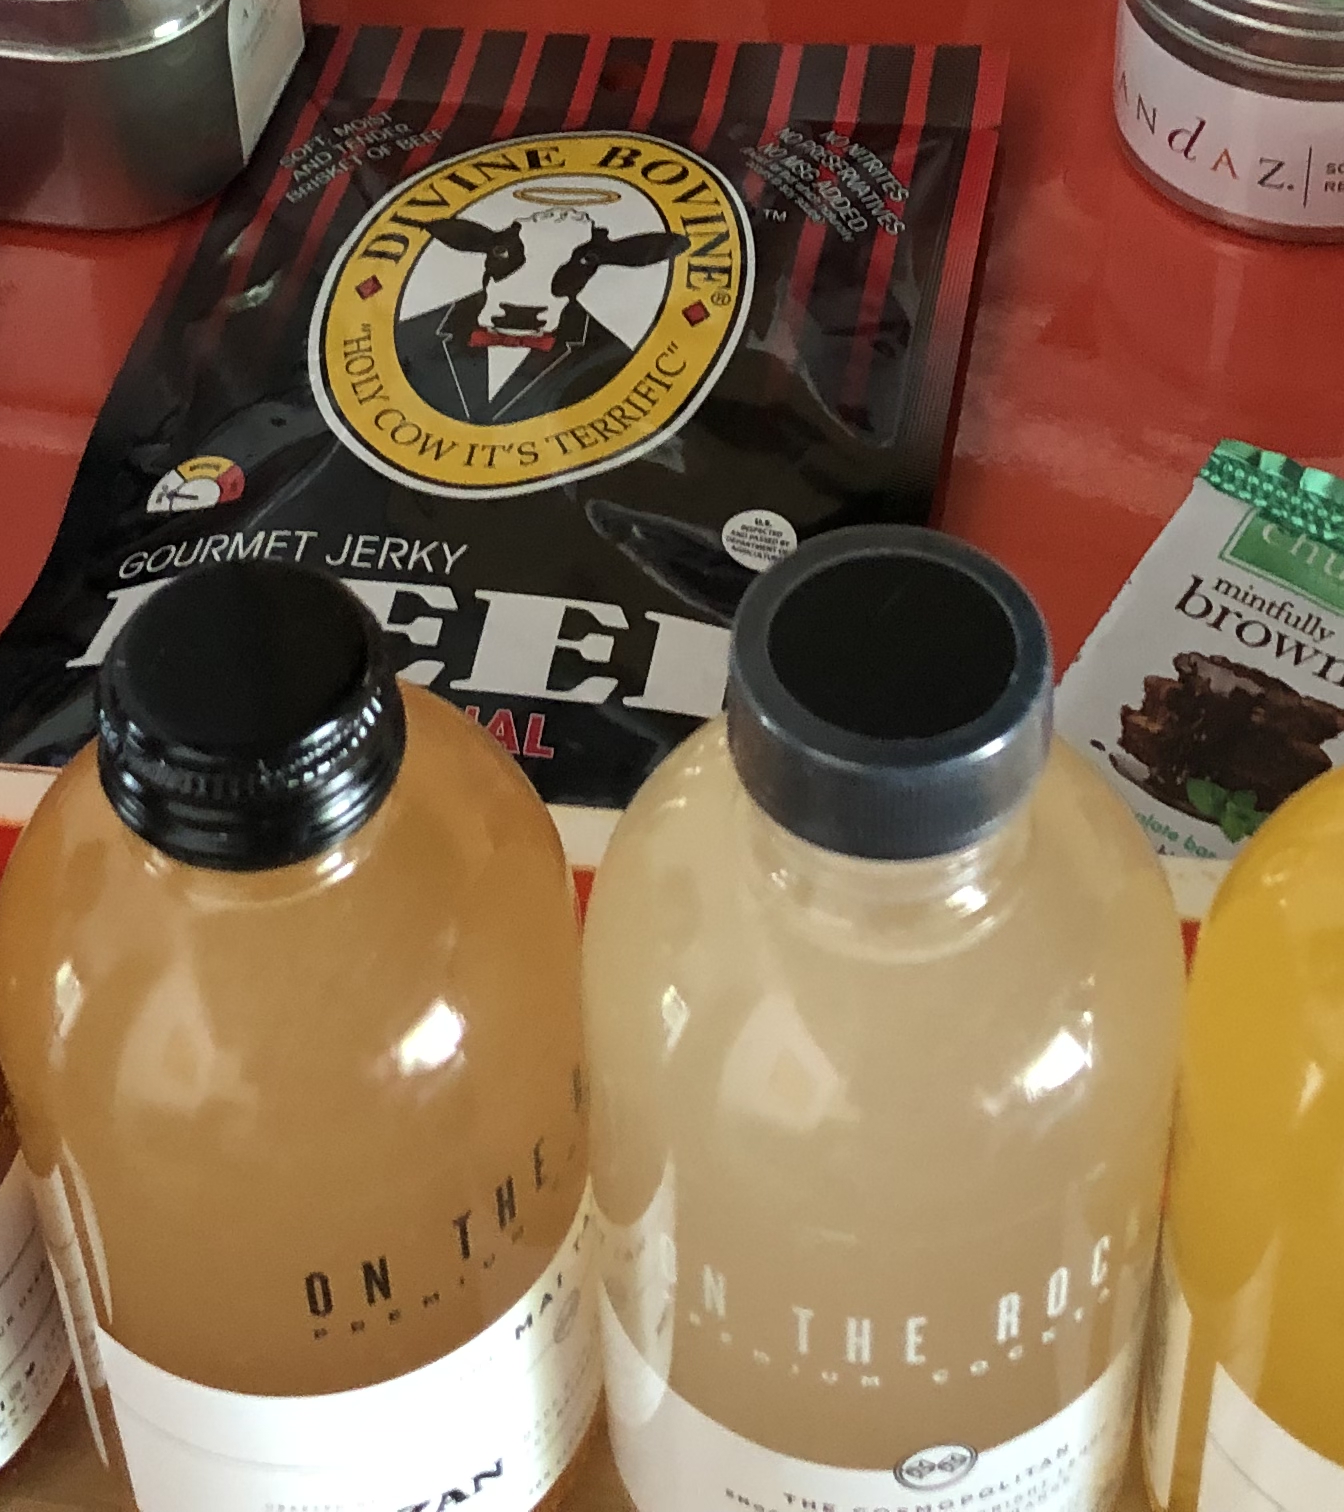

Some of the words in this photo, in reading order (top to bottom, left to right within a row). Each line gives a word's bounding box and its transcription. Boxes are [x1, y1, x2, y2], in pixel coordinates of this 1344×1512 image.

[292, 150, 333, 183] AND
[331, 122, 413, 155] TENDER
[332, 111, 394, 138] MOIST
[285, 153, 363, 205] BRISKET
[366, 144, 393, 161] OF
[395, 127, 444, 152] BEEF
[796, 139, 906, 236] PRESERVATIVES
[819, 130, 850, 148] NO
[842, 143, 910, 202] NITRITES
[359, 145, 567, 266] DIVINE
[591, 145, 734, 292] BOVINE
[812, 180, 869, 233] ADDED
[373, 407, 460, 462] COW
[462, 441, 540, 469] IT'S
[118, 529, 318, 581] GOURMET
[325, 532, 468, 576] JERKY
[1209, 574, 1336, 643] mintfully
[304, 1255, 393, 1318] ON
[453, 1136, 547, 1261] THE
[791, 1304, 929, 1366] THE
[996, 1235, 1113, 1345] ROC
